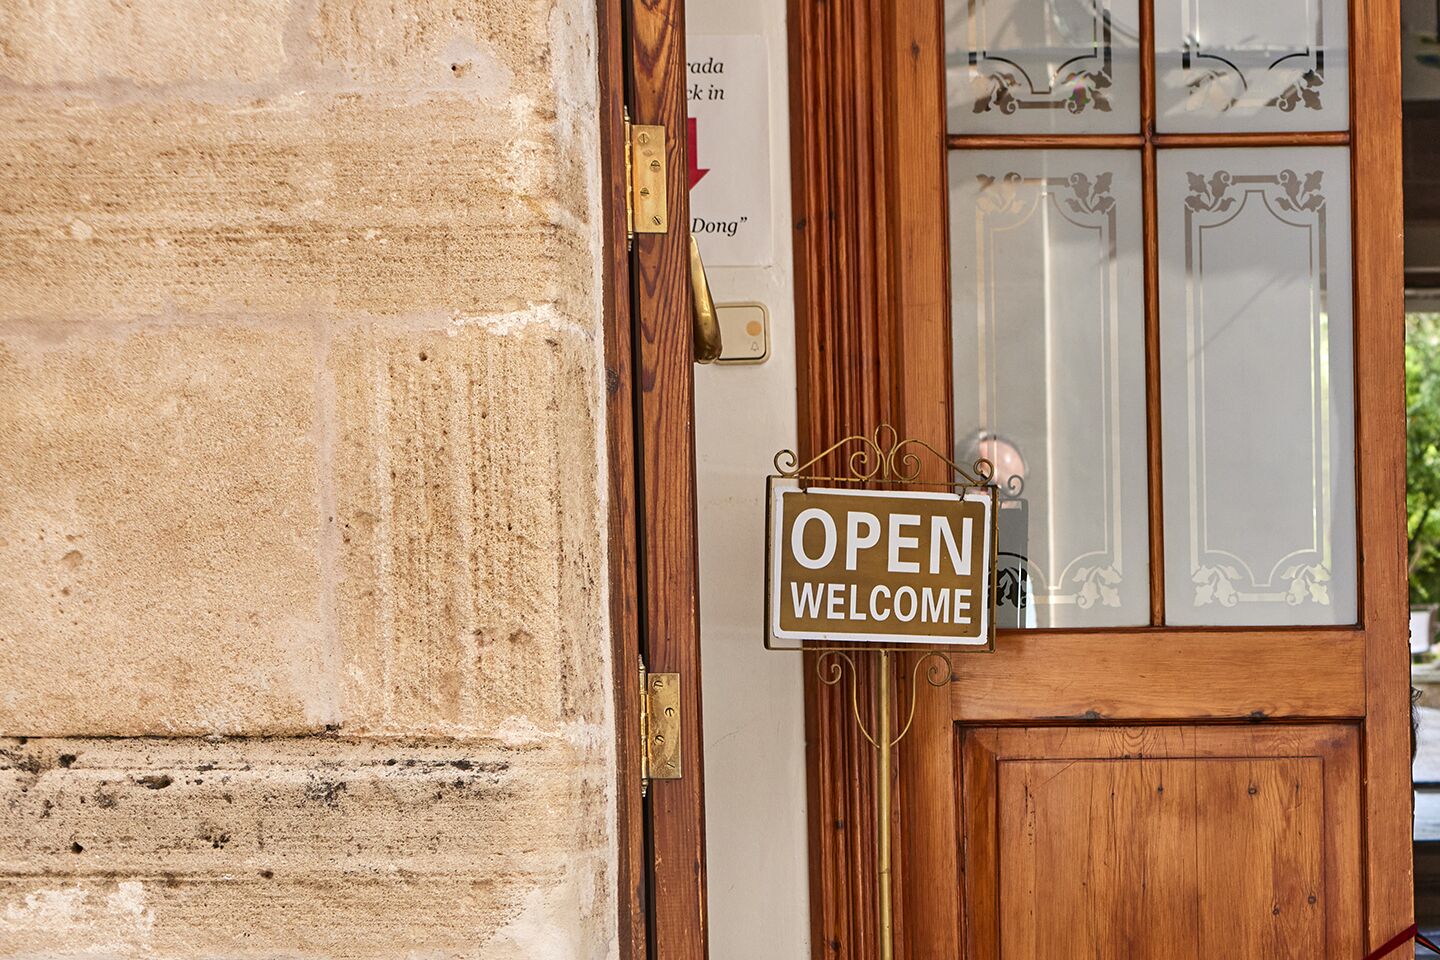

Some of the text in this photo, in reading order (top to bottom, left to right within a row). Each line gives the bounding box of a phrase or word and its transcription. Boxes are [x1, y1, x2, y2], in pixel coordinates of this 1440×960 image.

[687, 57, 724, 74] ada
[708, 84, 725, 100] in
[791, 507, 973, 576] OPEN
[791, 582, 972, 624] WELCOME
